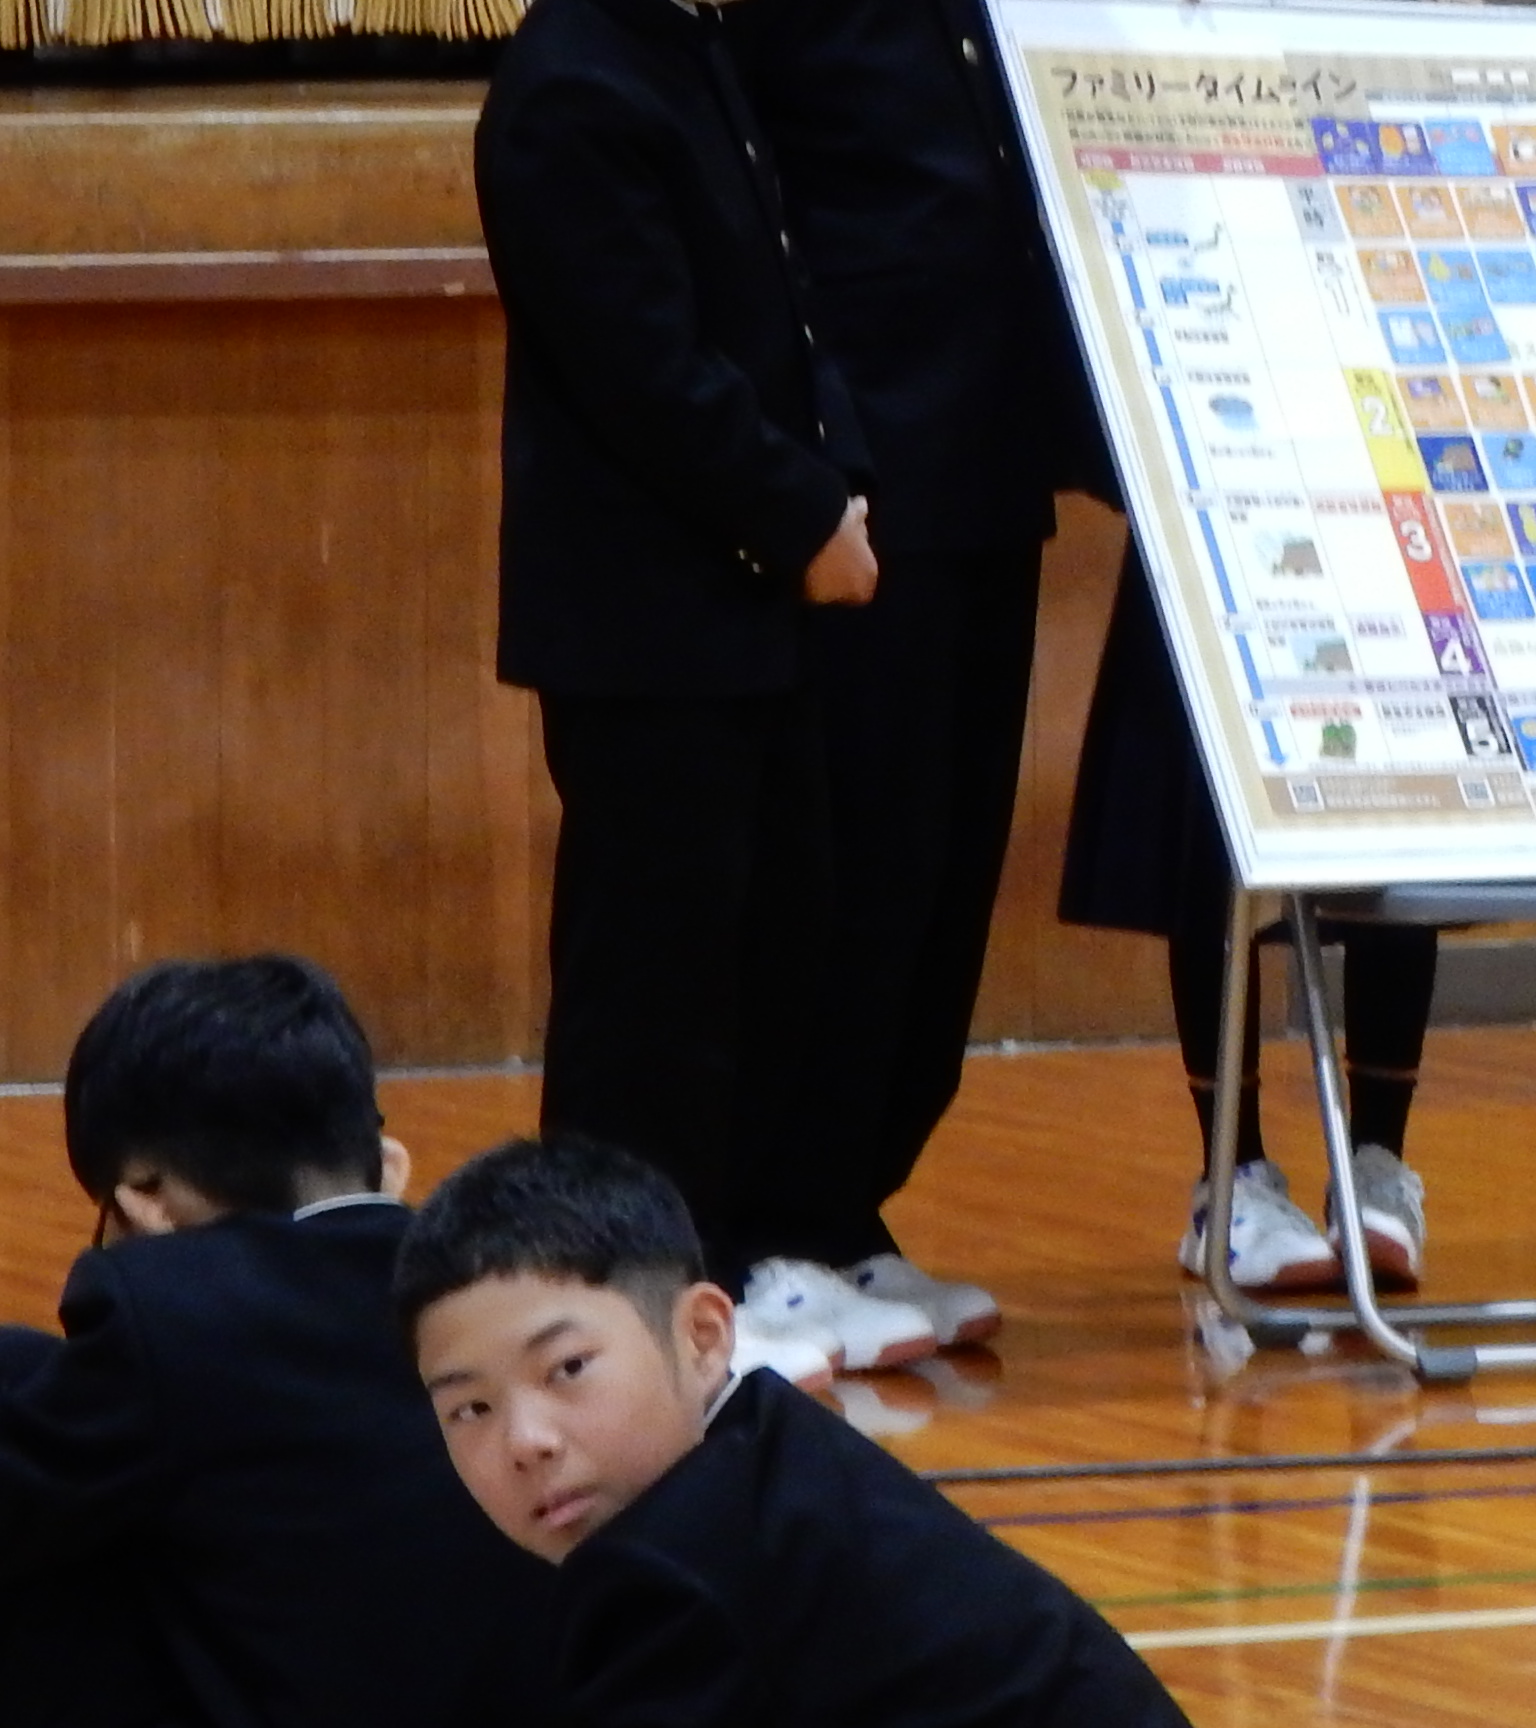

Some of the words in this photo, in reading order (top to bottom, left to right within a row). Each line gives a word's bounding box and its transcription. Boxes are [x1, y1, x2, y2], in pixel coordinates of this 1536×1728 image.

[1361, 396, 1394, 436] 2
[1400, 520, 1433, 562] 3
[1441, 636, 1472, 677] 4
